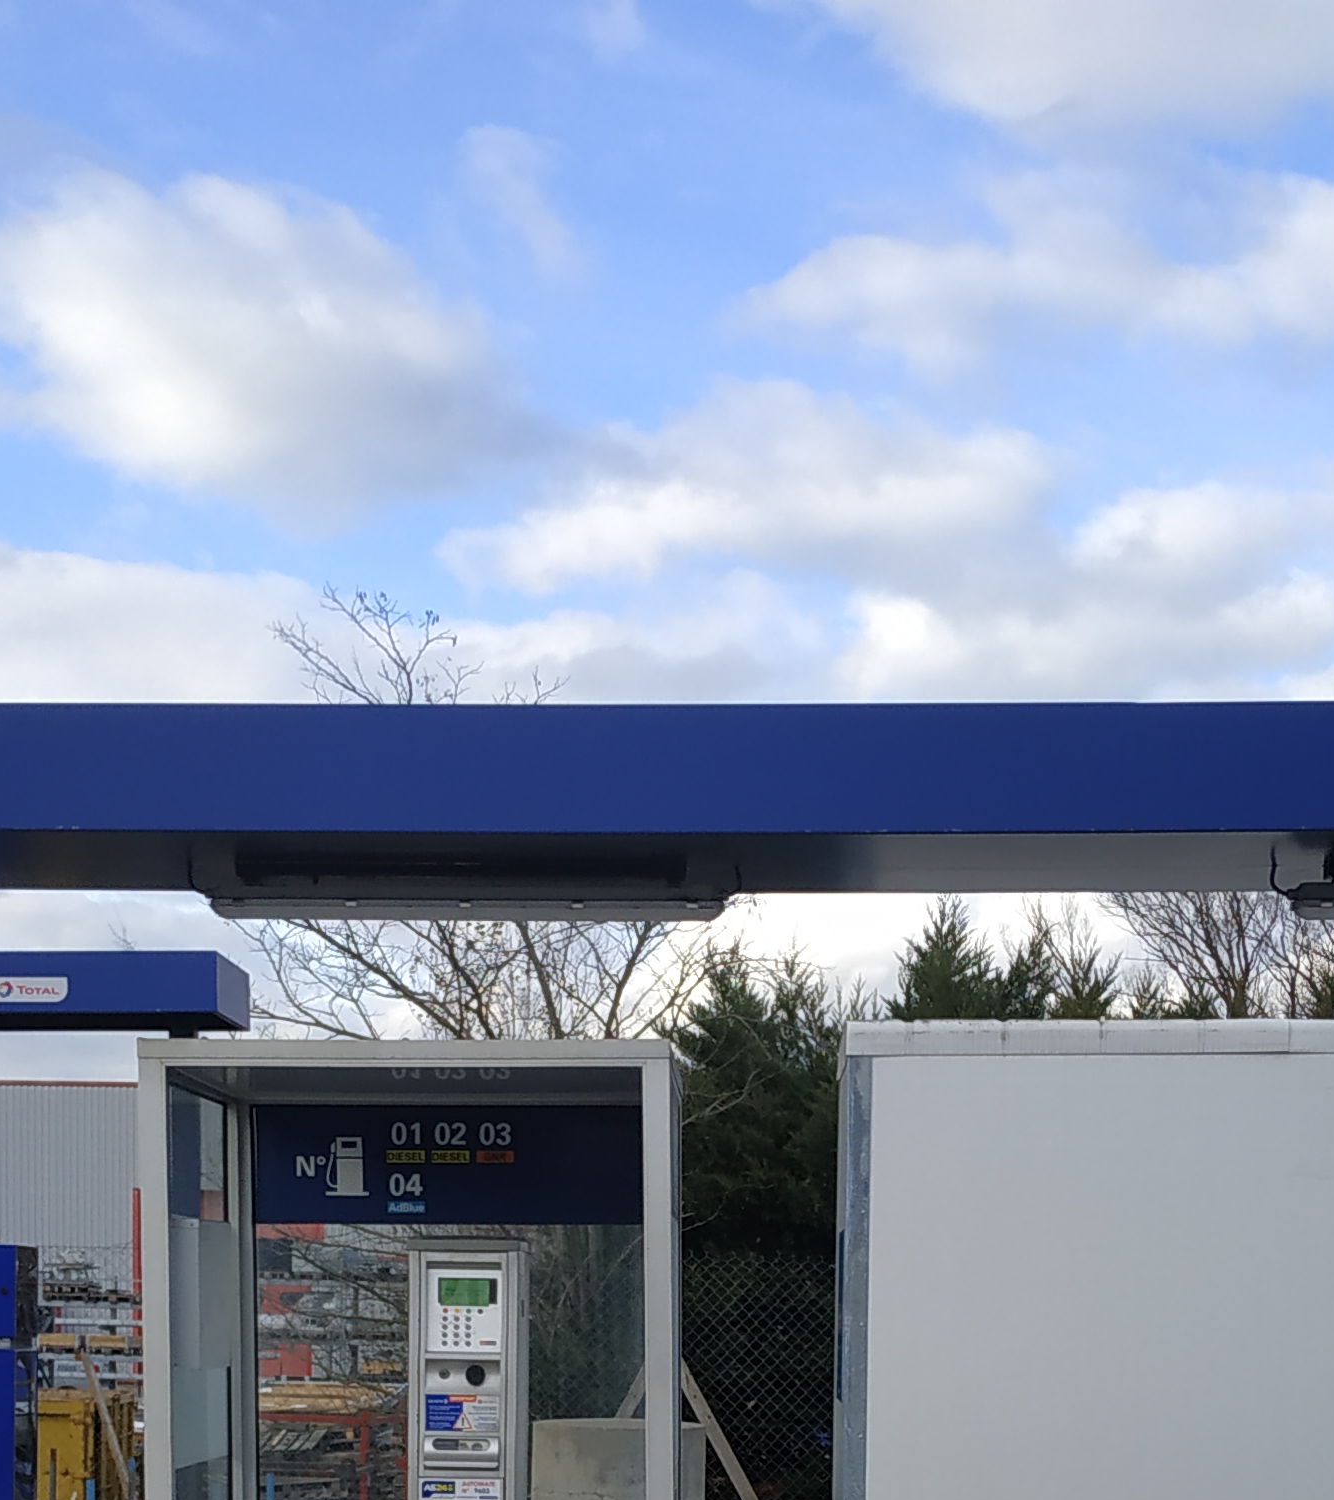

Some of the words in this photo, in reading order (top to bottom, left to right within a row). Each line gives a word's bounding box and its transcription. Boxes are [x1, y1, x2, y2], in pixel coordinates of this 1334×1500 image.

[16, 984, 60, 996] TOTAL
[390, 1121, 422, 1146] 01
[433, 1121, 467, 1146] 02
[478, 1122, 512, 1146] 03
[386, 1151, 425, 1163] DIESEL
[431, 1151, 469, 1163] DIESEL
[295, 1155, 327, 1178] N°
[388, 1173, 424, 1197] 04
[387, 1202, 425, 1213] AdBlue
